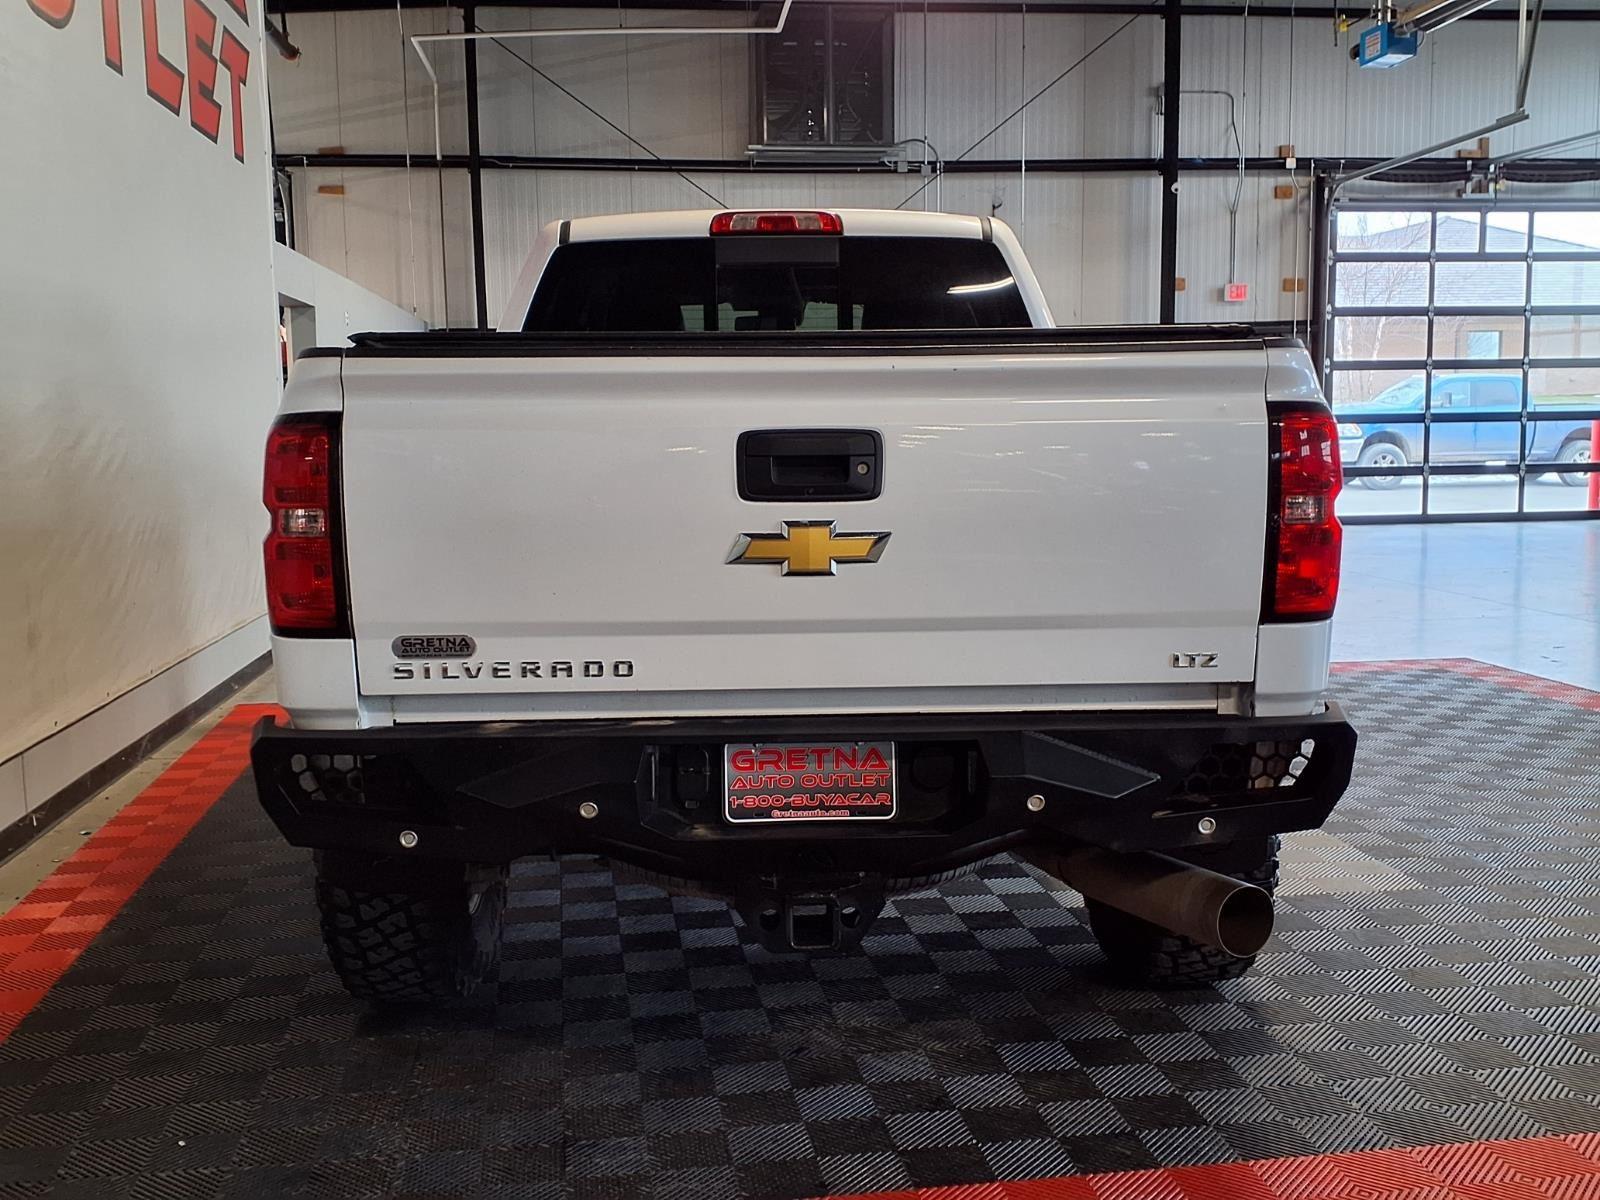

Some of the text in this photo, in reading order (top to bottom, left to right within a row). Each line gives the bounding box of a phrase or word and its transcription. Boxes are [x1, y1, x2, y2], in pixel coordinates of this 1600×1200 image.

[401, 637, 471, 647] GRETNA
[1170, 652, 1218, 668] LTZ
[393, 661, 634, 679] SILVERADO
[730, 747, 890, 773] GRETNA
[730, 773, 891, 790] AUTO OUTLET
[730, 793, 892, 808] 1-800-BUYACAR
